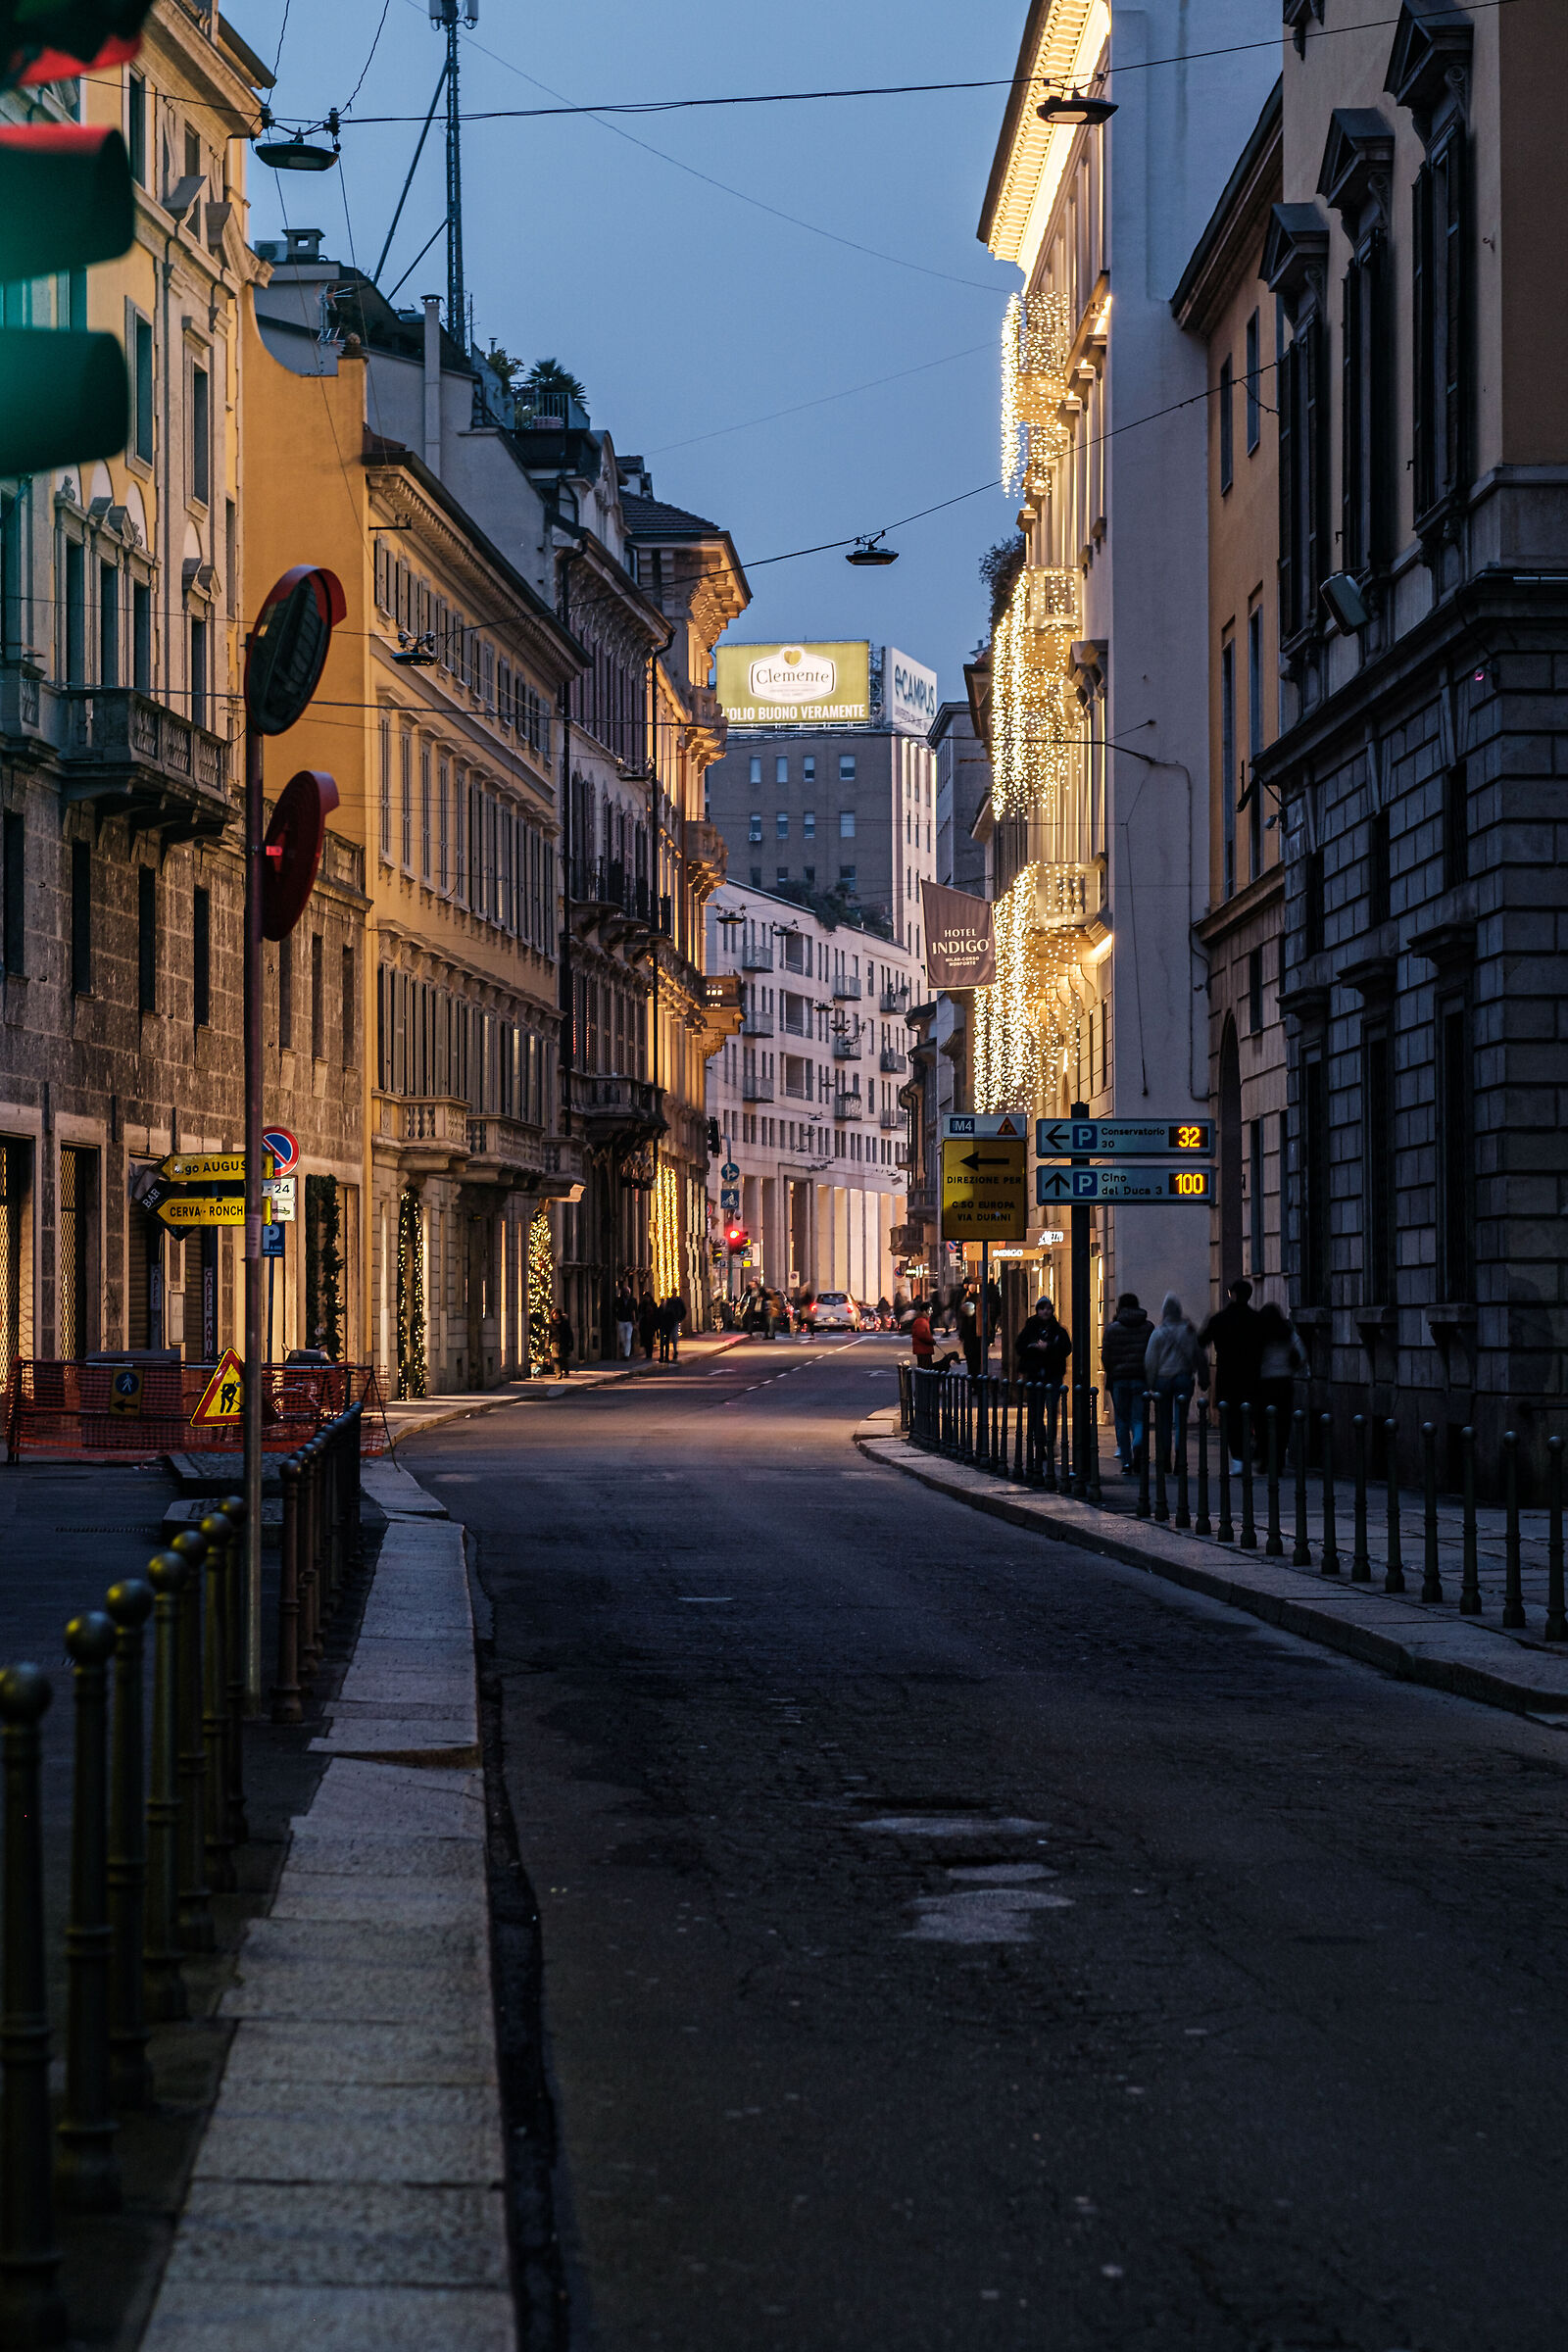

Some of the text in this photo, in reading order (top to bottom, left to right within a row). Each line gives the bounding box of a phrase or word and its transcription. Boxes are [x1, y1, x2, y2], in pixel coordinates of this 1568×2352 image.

[756, 668, 829, 684] Clemente
[759, 706, 798, 720] BUONO
[801, 704, 865, 719] VERAMENTE
[944, 928, 977, 938] HOTEL
[932, 938, 990, 955] INDIGO
[1080, 1128, 1093, 1147] P
[1101, 1127, 1165, 1136] Conservatorio
[1177, 1126, 1200, 1149] 32
[1102, 1140, 1115, 1149] 30
[203, 1159, 265, 1173] AUGUS
[947, 1176, 1021, 1185] DIREZIONE PER
[1102, 1172, 1127, 1183] Cino
[274, 1184, 290, 1194] 24
[1080, 1175, 1093, 1194] P
[1175, 1173, 1204, 1195] 100
[1102, 1186, 1163, 1196] del Duca 3
[142, 1187, 161, 1208] BAR
[170, 1206, 200, 1217] CERVA
[956, 1212, 1011, 1221] VIA DURINI
